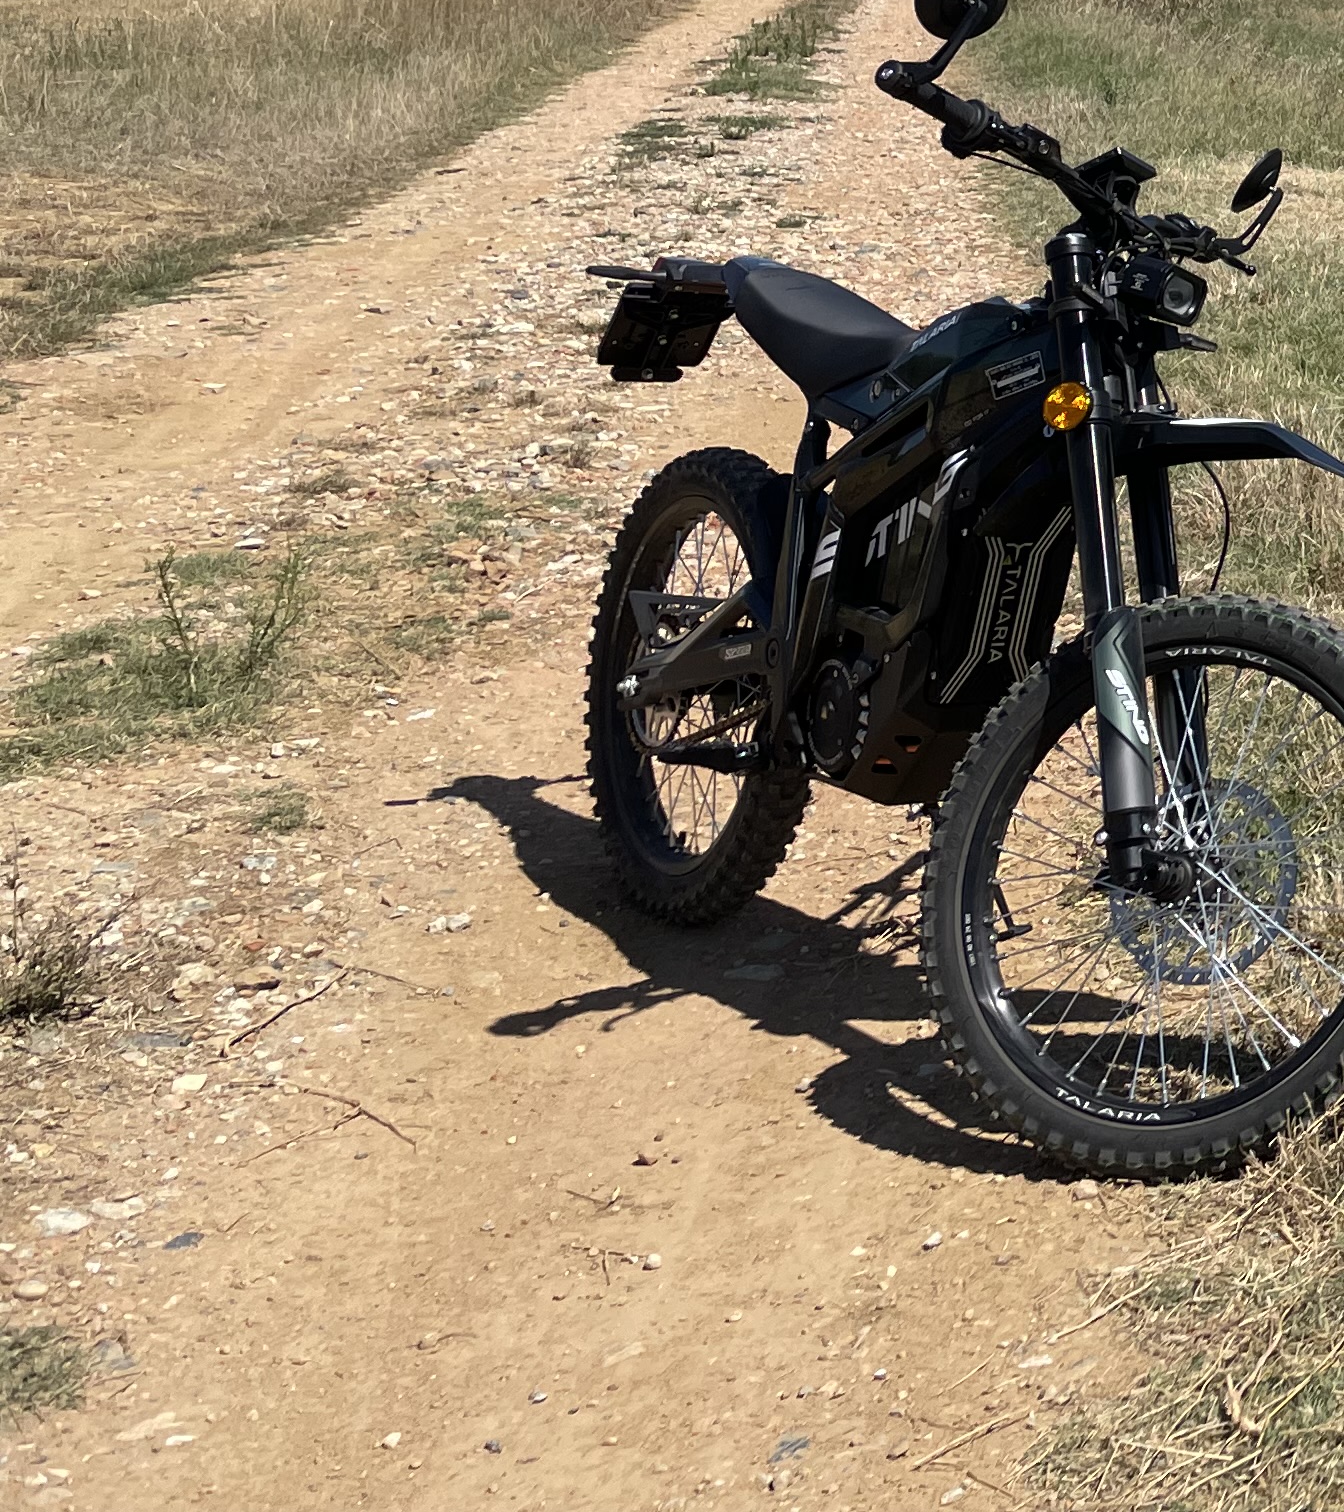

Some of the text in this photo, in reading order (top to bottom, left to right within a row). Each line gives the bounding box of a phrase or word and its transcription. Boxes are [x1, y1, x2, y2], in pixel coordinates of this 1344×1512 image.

[987, 565, 1022, 664] TALARIA
[1164, 646, 1273, 667] TALARIA
[1055, 1087, 1161, 1122] TALARIA
